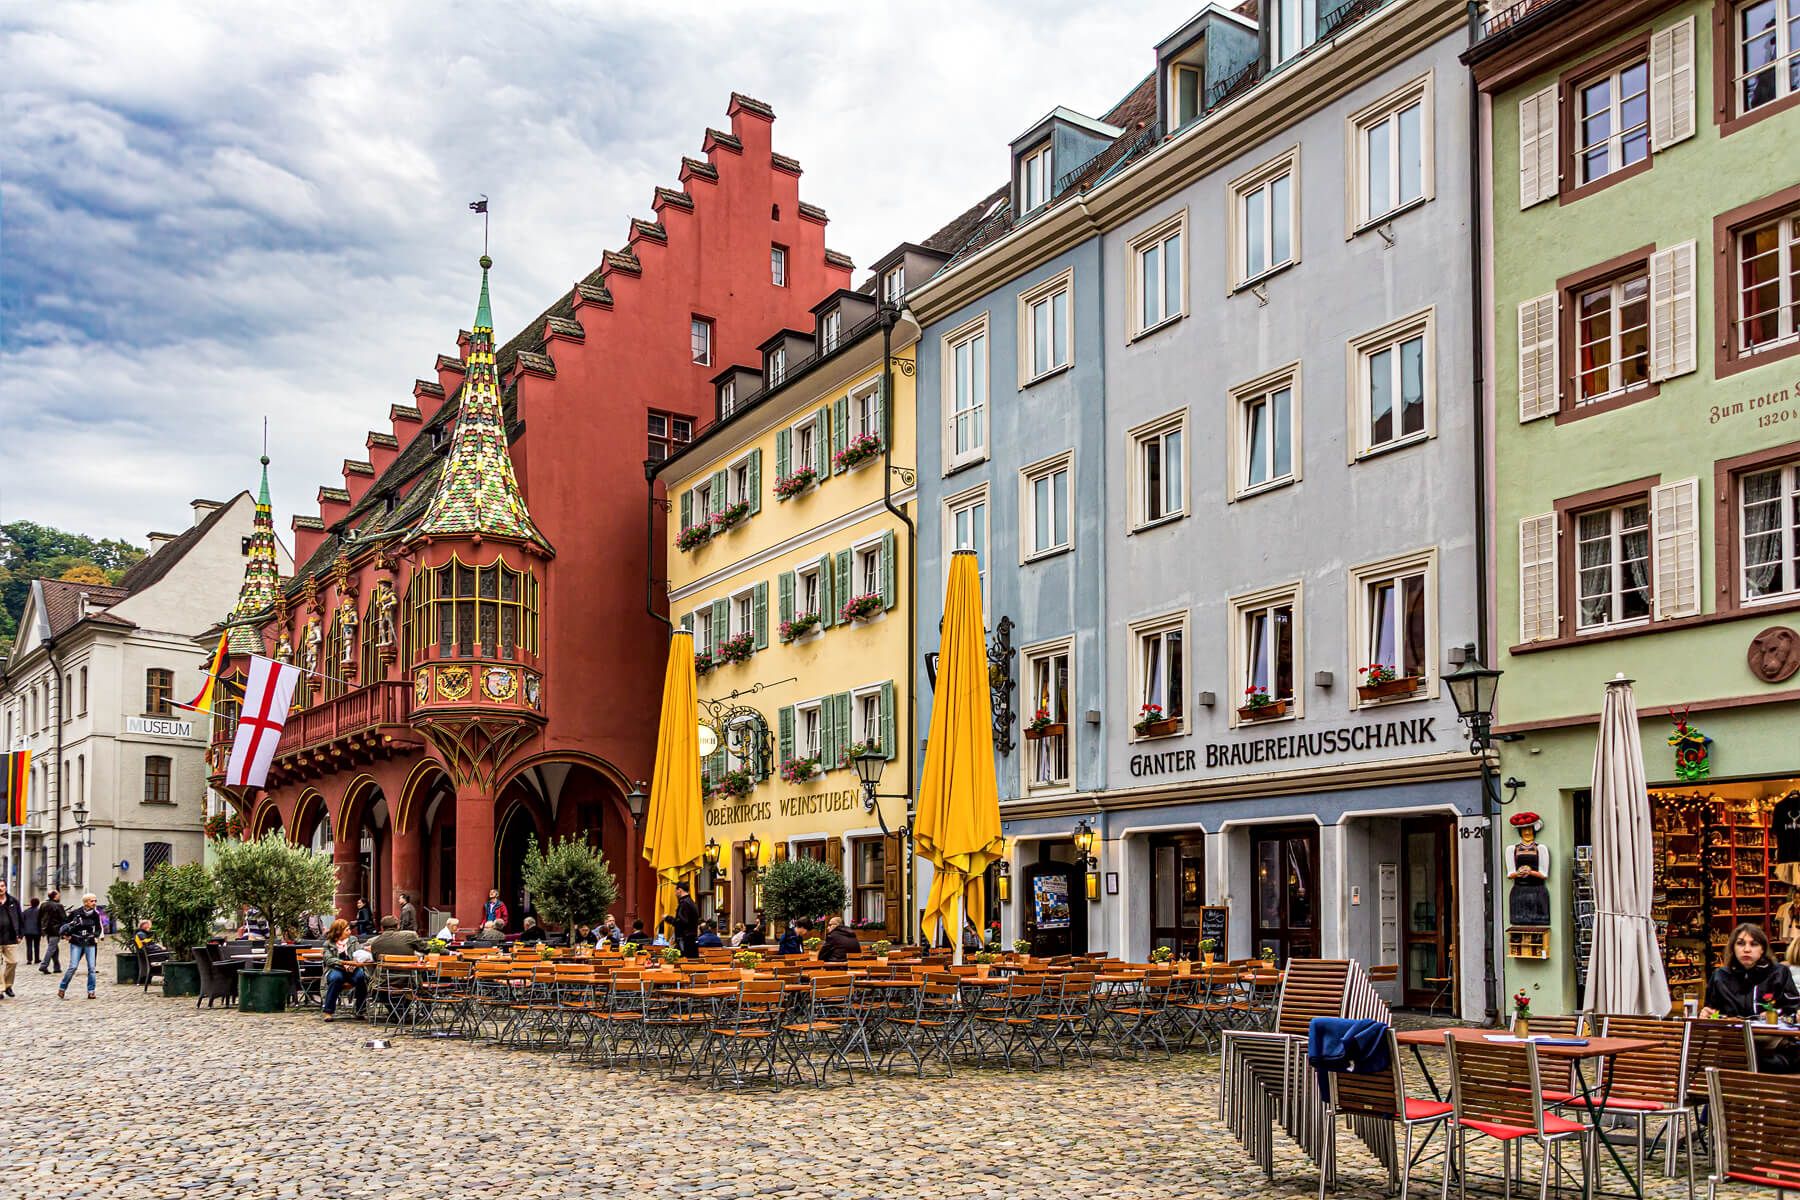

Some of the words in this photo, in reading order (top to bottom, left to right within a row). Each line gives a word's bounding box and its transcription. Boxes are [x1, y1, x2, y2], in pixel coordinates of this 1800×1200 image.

[1710, 402, 1744, 424] Zum
[1749, 389, 1789, 410] roten
[1758, 410, 1789, 428] 1320
[129, 719, 190, 736] MUSEUM
[1130, 749, 1196, 777] GANTER
[1206, 717, 1436, 768] BRAUEREIAUSSCHANK
[706, 801, 772, 826] OBERKIRCHS
[779, 789, 860, 817] WEINSTUBEN
